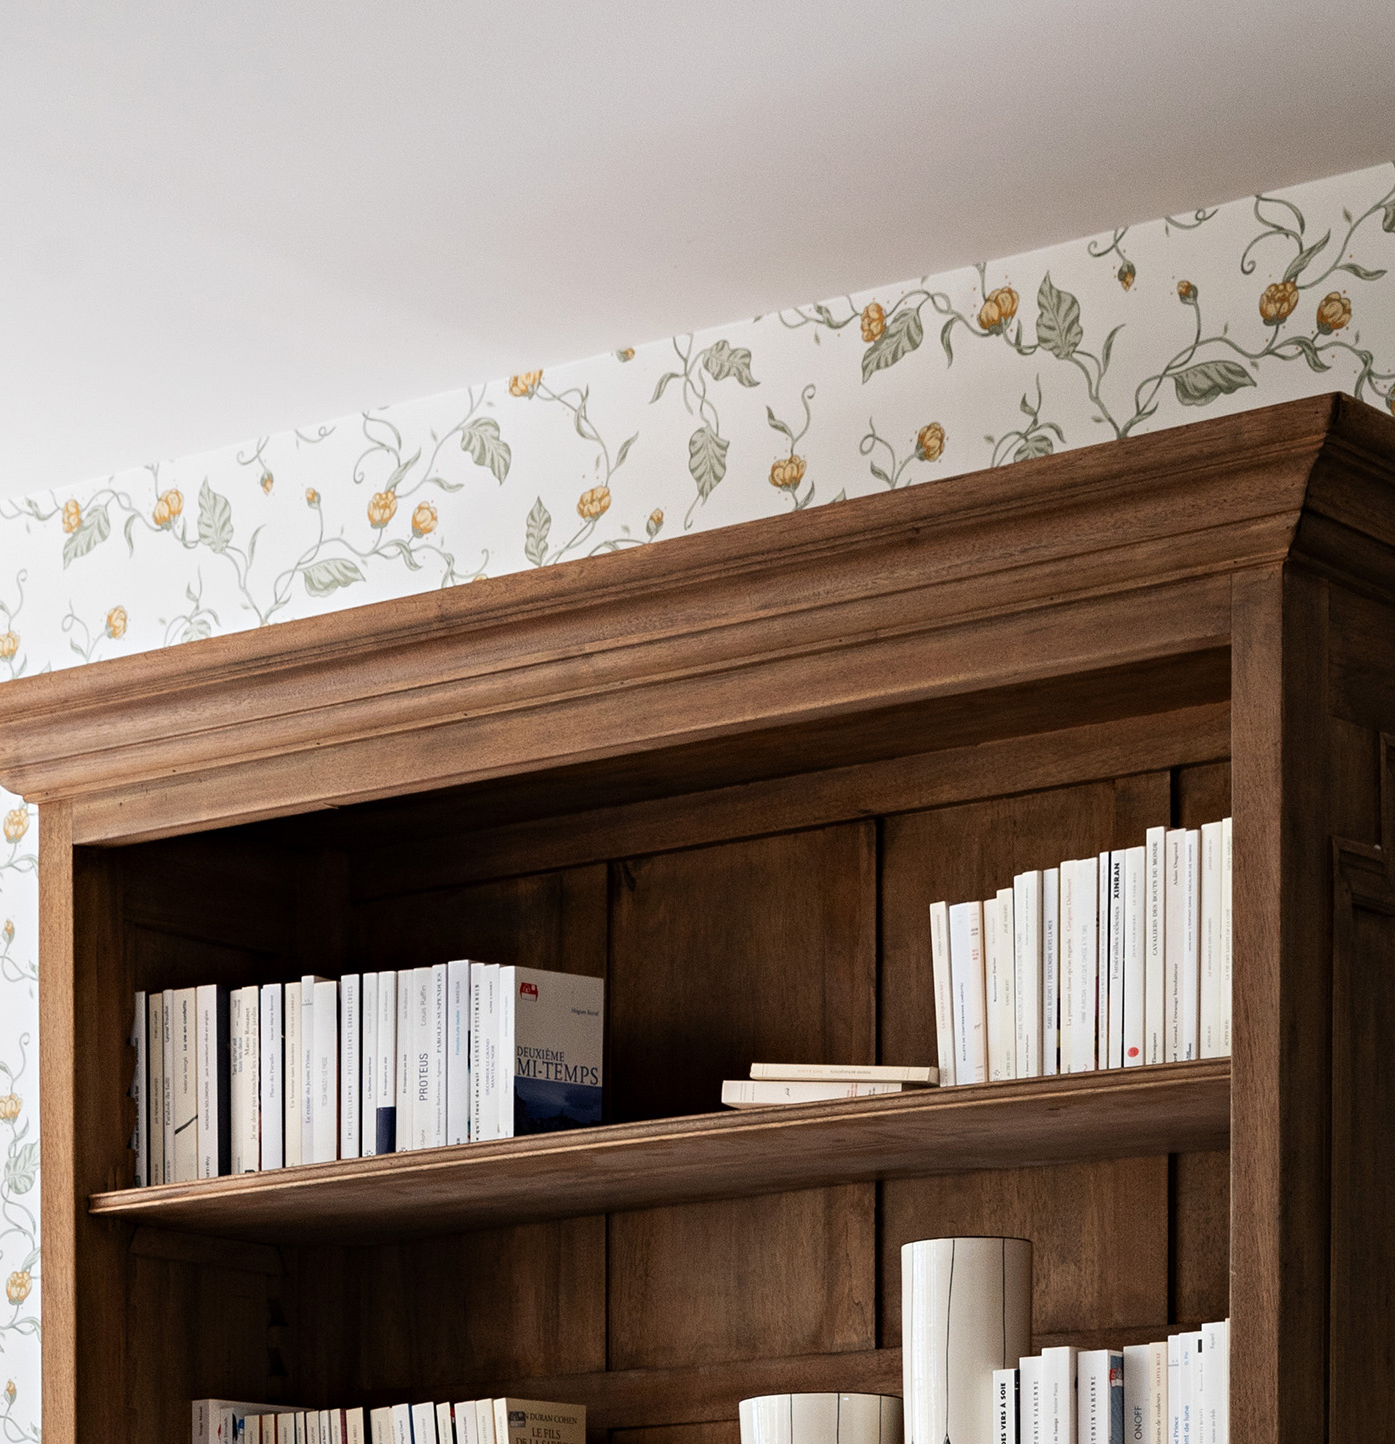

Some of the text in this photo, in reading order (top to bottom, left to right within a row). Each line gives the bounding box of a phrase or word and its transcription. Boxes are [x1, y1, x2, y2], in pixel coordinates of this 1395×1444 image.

[1152, 868, 1158, 878] DU
[1112, 906, 1120, 935] célestes
[419, 985, 427, 1005] Raffin
[1066, 1018, 1072, 1027] La
[251, 1027, 257, 1037] du
[517, 1045, 565, 1062] DEUXIÈME
[419, 1052, 429, 1101] PROTEUS
[517, 1057, 599, 1086] MI-TEMPS
[530, 1413, 577, 1424] DURAN COHEN
[1134, 1405, 1143, 1440] ONOFF
[1155, 1418, 1161, 1426] de
[1183, 1423, 1190, 1432] de
[531, 1428, 561, 1440] LE FILS
